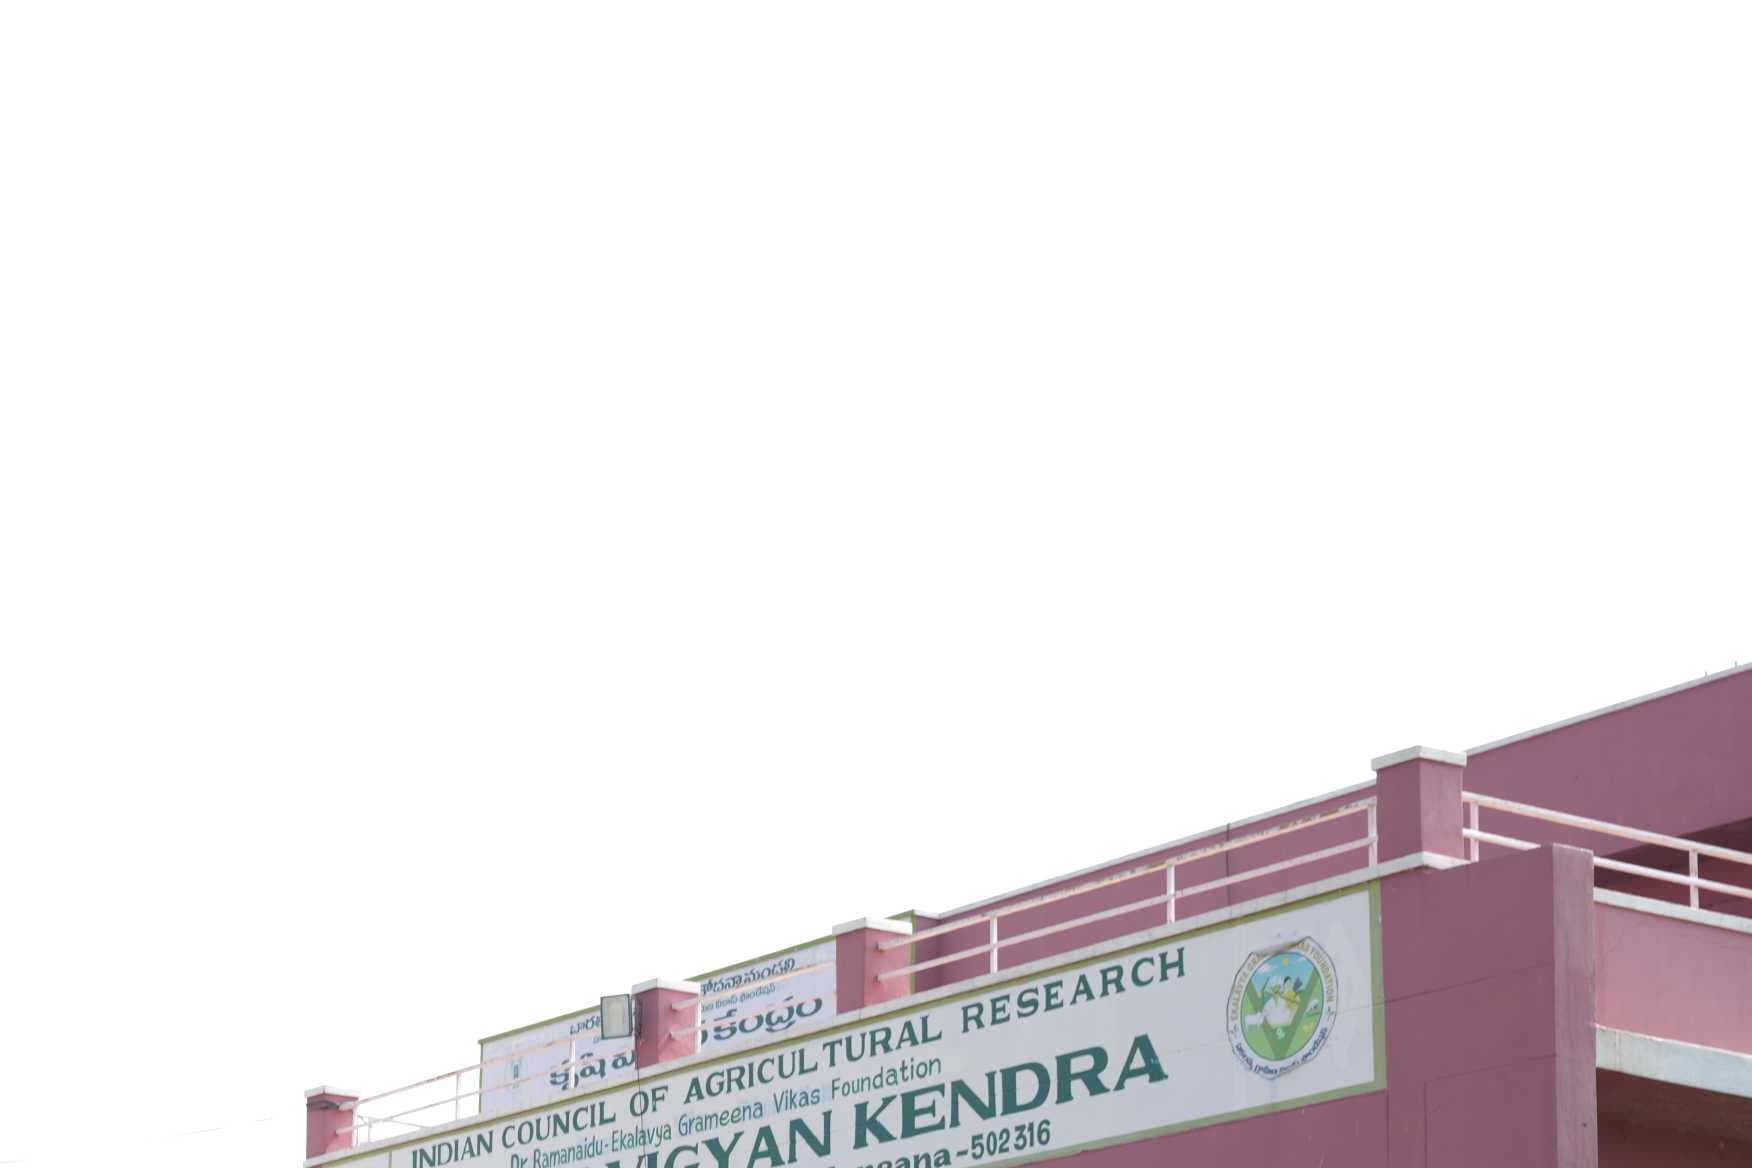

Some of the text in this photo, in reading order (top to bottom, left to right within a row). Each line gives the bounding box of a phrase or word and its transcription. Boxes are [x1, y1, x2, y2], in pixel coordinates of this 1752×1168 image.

[502, 1101, 617, 1149] COUNCIL
[629, 1085, 669, 1117] OF
[683, 1014, 943, 1104] AGRICULTURAL
[961, 946, 1186, 1034] RESEARCH
[678, 1101, 764, 1136] Grameena
[773, 1087, 821, 1114] Vikas
[831, 1056, 942, 1100] Foundation
[852, 1033, 1169, 1150] KENDRA
